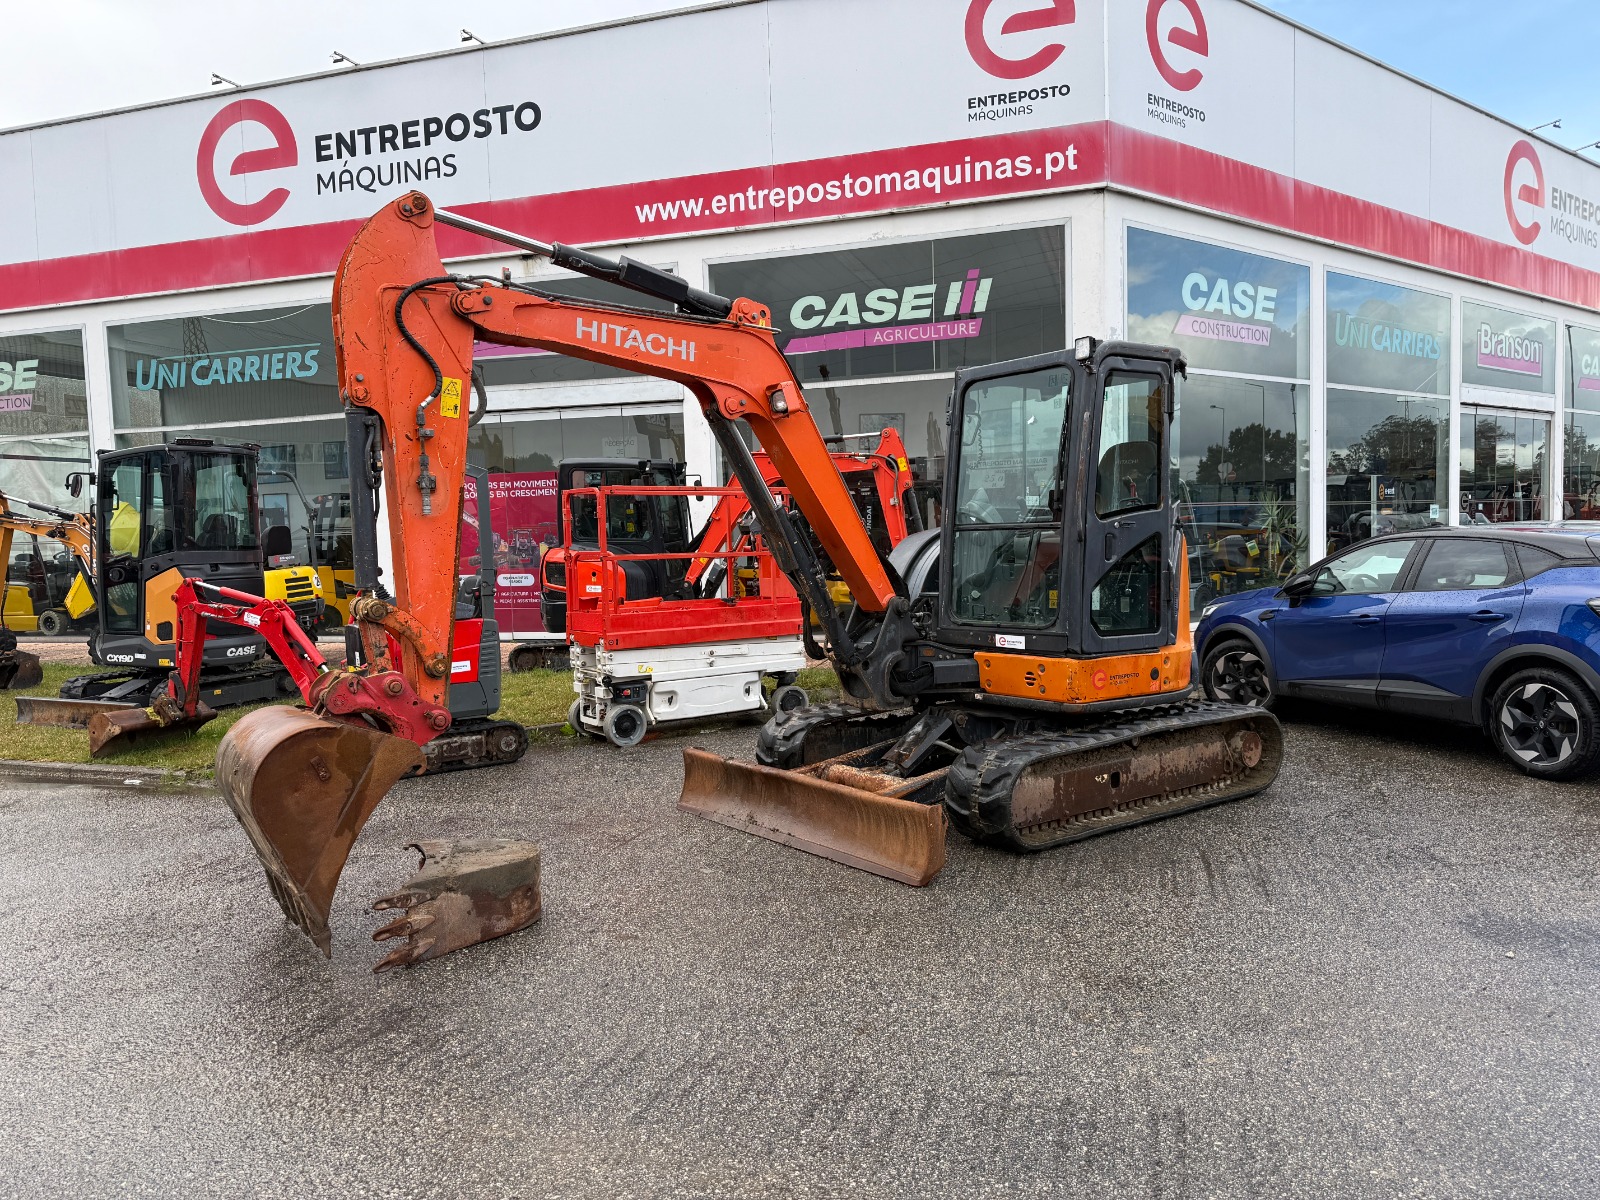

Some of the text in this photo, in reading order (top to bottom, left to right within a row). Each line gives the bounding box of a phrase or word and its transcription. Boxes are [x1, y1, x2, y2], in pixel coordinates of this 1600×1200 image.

[968, 84, 1071, 109] ENTREPOSTO
[1147, 92, 1206, 122] ENTREPOSTO
[968, 104, 1033, 122] MÁQUINAS
[1147, 106, 1186, 128] MÁQUINAS
[314, 101, 542, 163] ENTREPOSTO
[316, 153, 458, 195] MÁQUINAS
[634, 144, 1078, 223] www.entrepostomaquinas.pt
[1550, 213, 1598, 248] MÁQUINAS
[789, 284, 937, 330] CASE
[1182, 272, 1278, 322] CASE
[576, 317, 696, 362] HITACHI
[873, 322, 977, 343] AGRICULTURE
[1191, 320, 1269, 343] CONSTRUCTION
[1480, 321, 1540, 364] Branson
[499, 481, 512, 489] EM
[513, 479, 559, 488] MOVIMENT
[106, 653, 134, 663] CX19D
[226, 644, 257, 657] CASE
[1109, 672, 1140, 681] ENTREPOSTO
